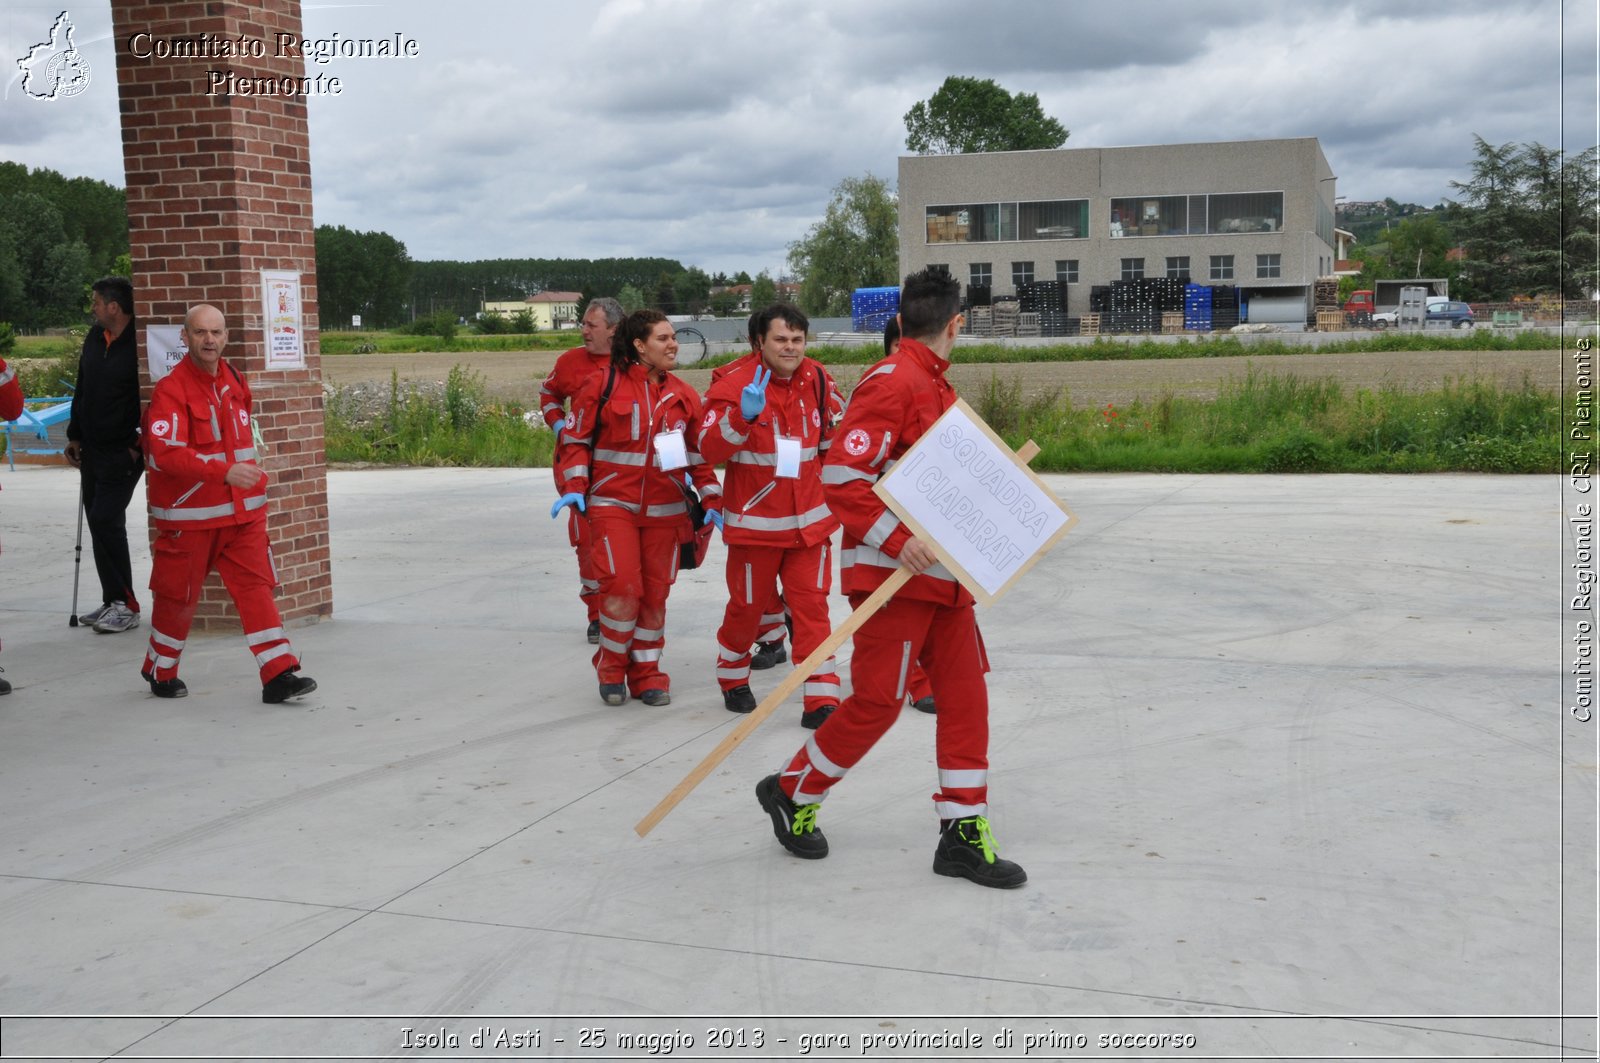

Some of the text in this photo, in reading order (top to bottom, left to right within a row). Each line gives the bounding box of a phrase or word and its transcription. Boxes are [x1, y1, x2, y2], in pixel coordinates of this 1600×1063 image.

[166, 351, 186, 361] PRO
[902, 452, 1025, 572] I CIAPARAT
[939, 424, 1049, 538] SQUADRA
